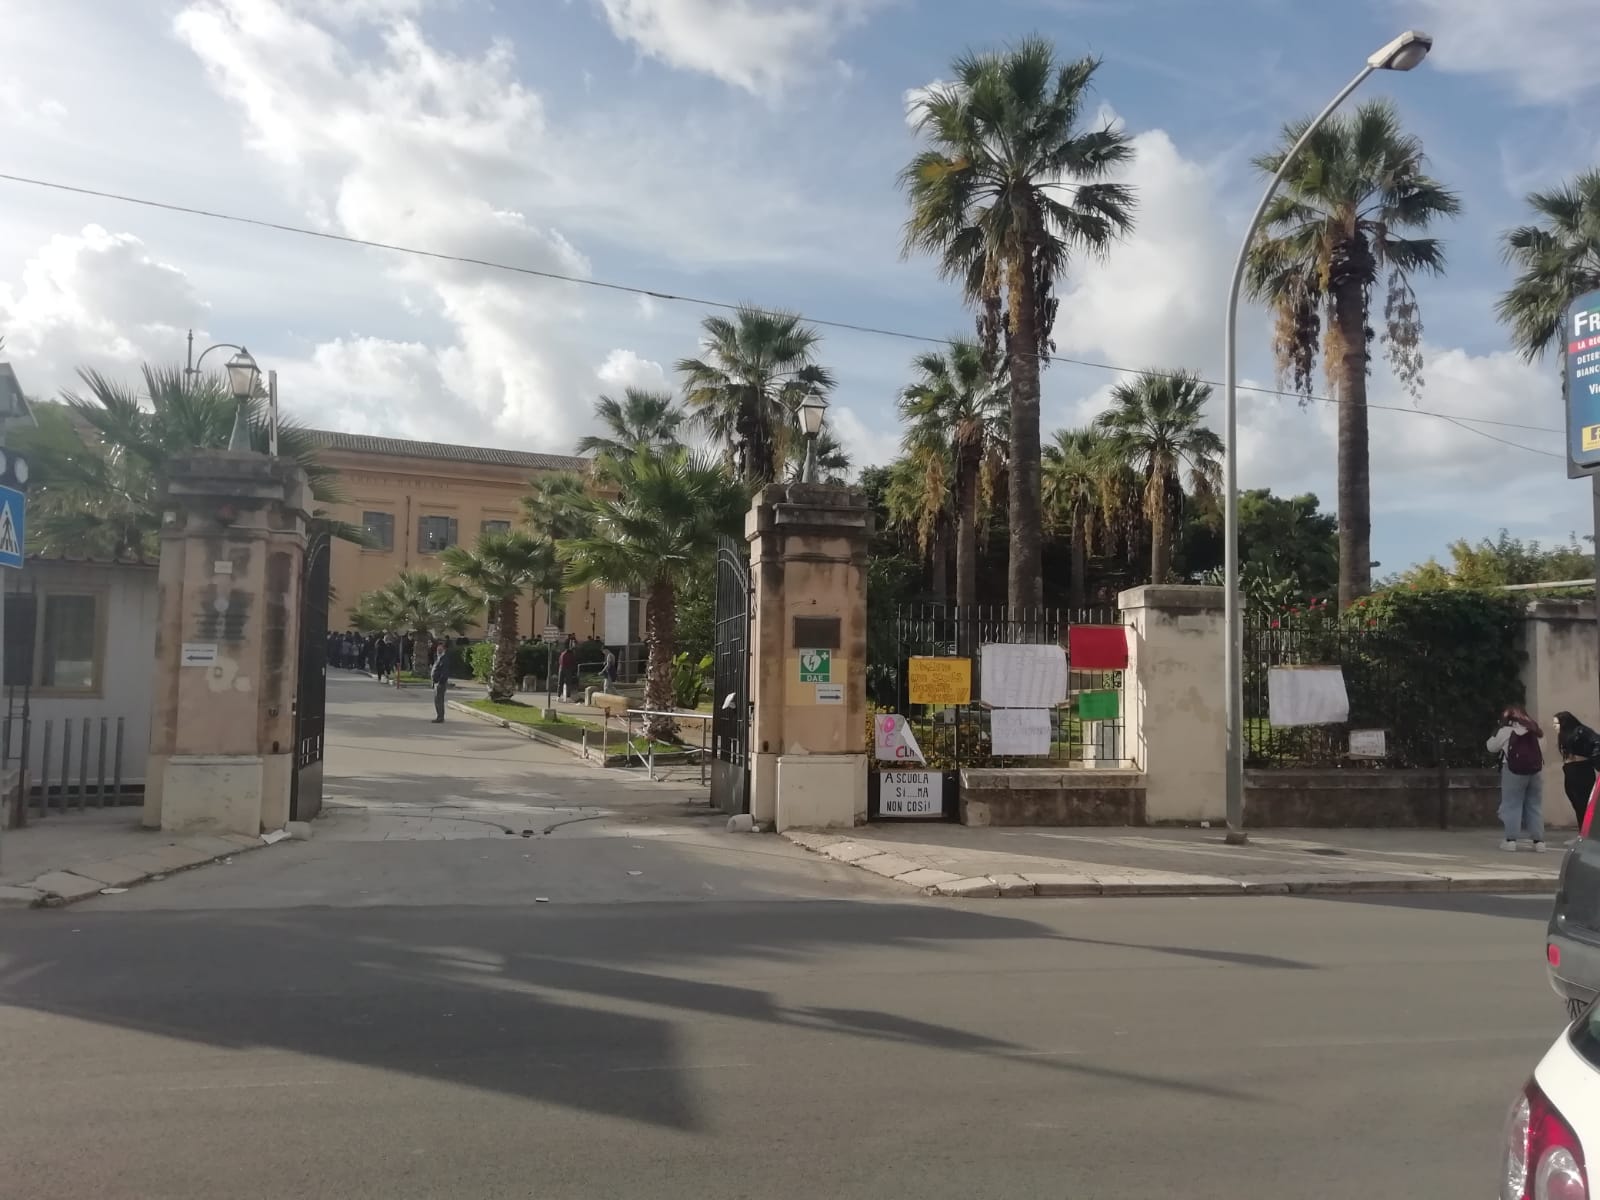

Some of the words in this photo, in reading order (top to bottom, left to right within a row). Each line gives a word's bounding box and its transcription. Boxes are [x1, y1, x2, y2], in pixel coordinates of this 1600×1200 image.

[1577, 340, 1586, 350] LA
[885, 772, 894, 783] A
[896, 773, 929, 784] SCUOLA
[886, 800, 902, 812] NON
